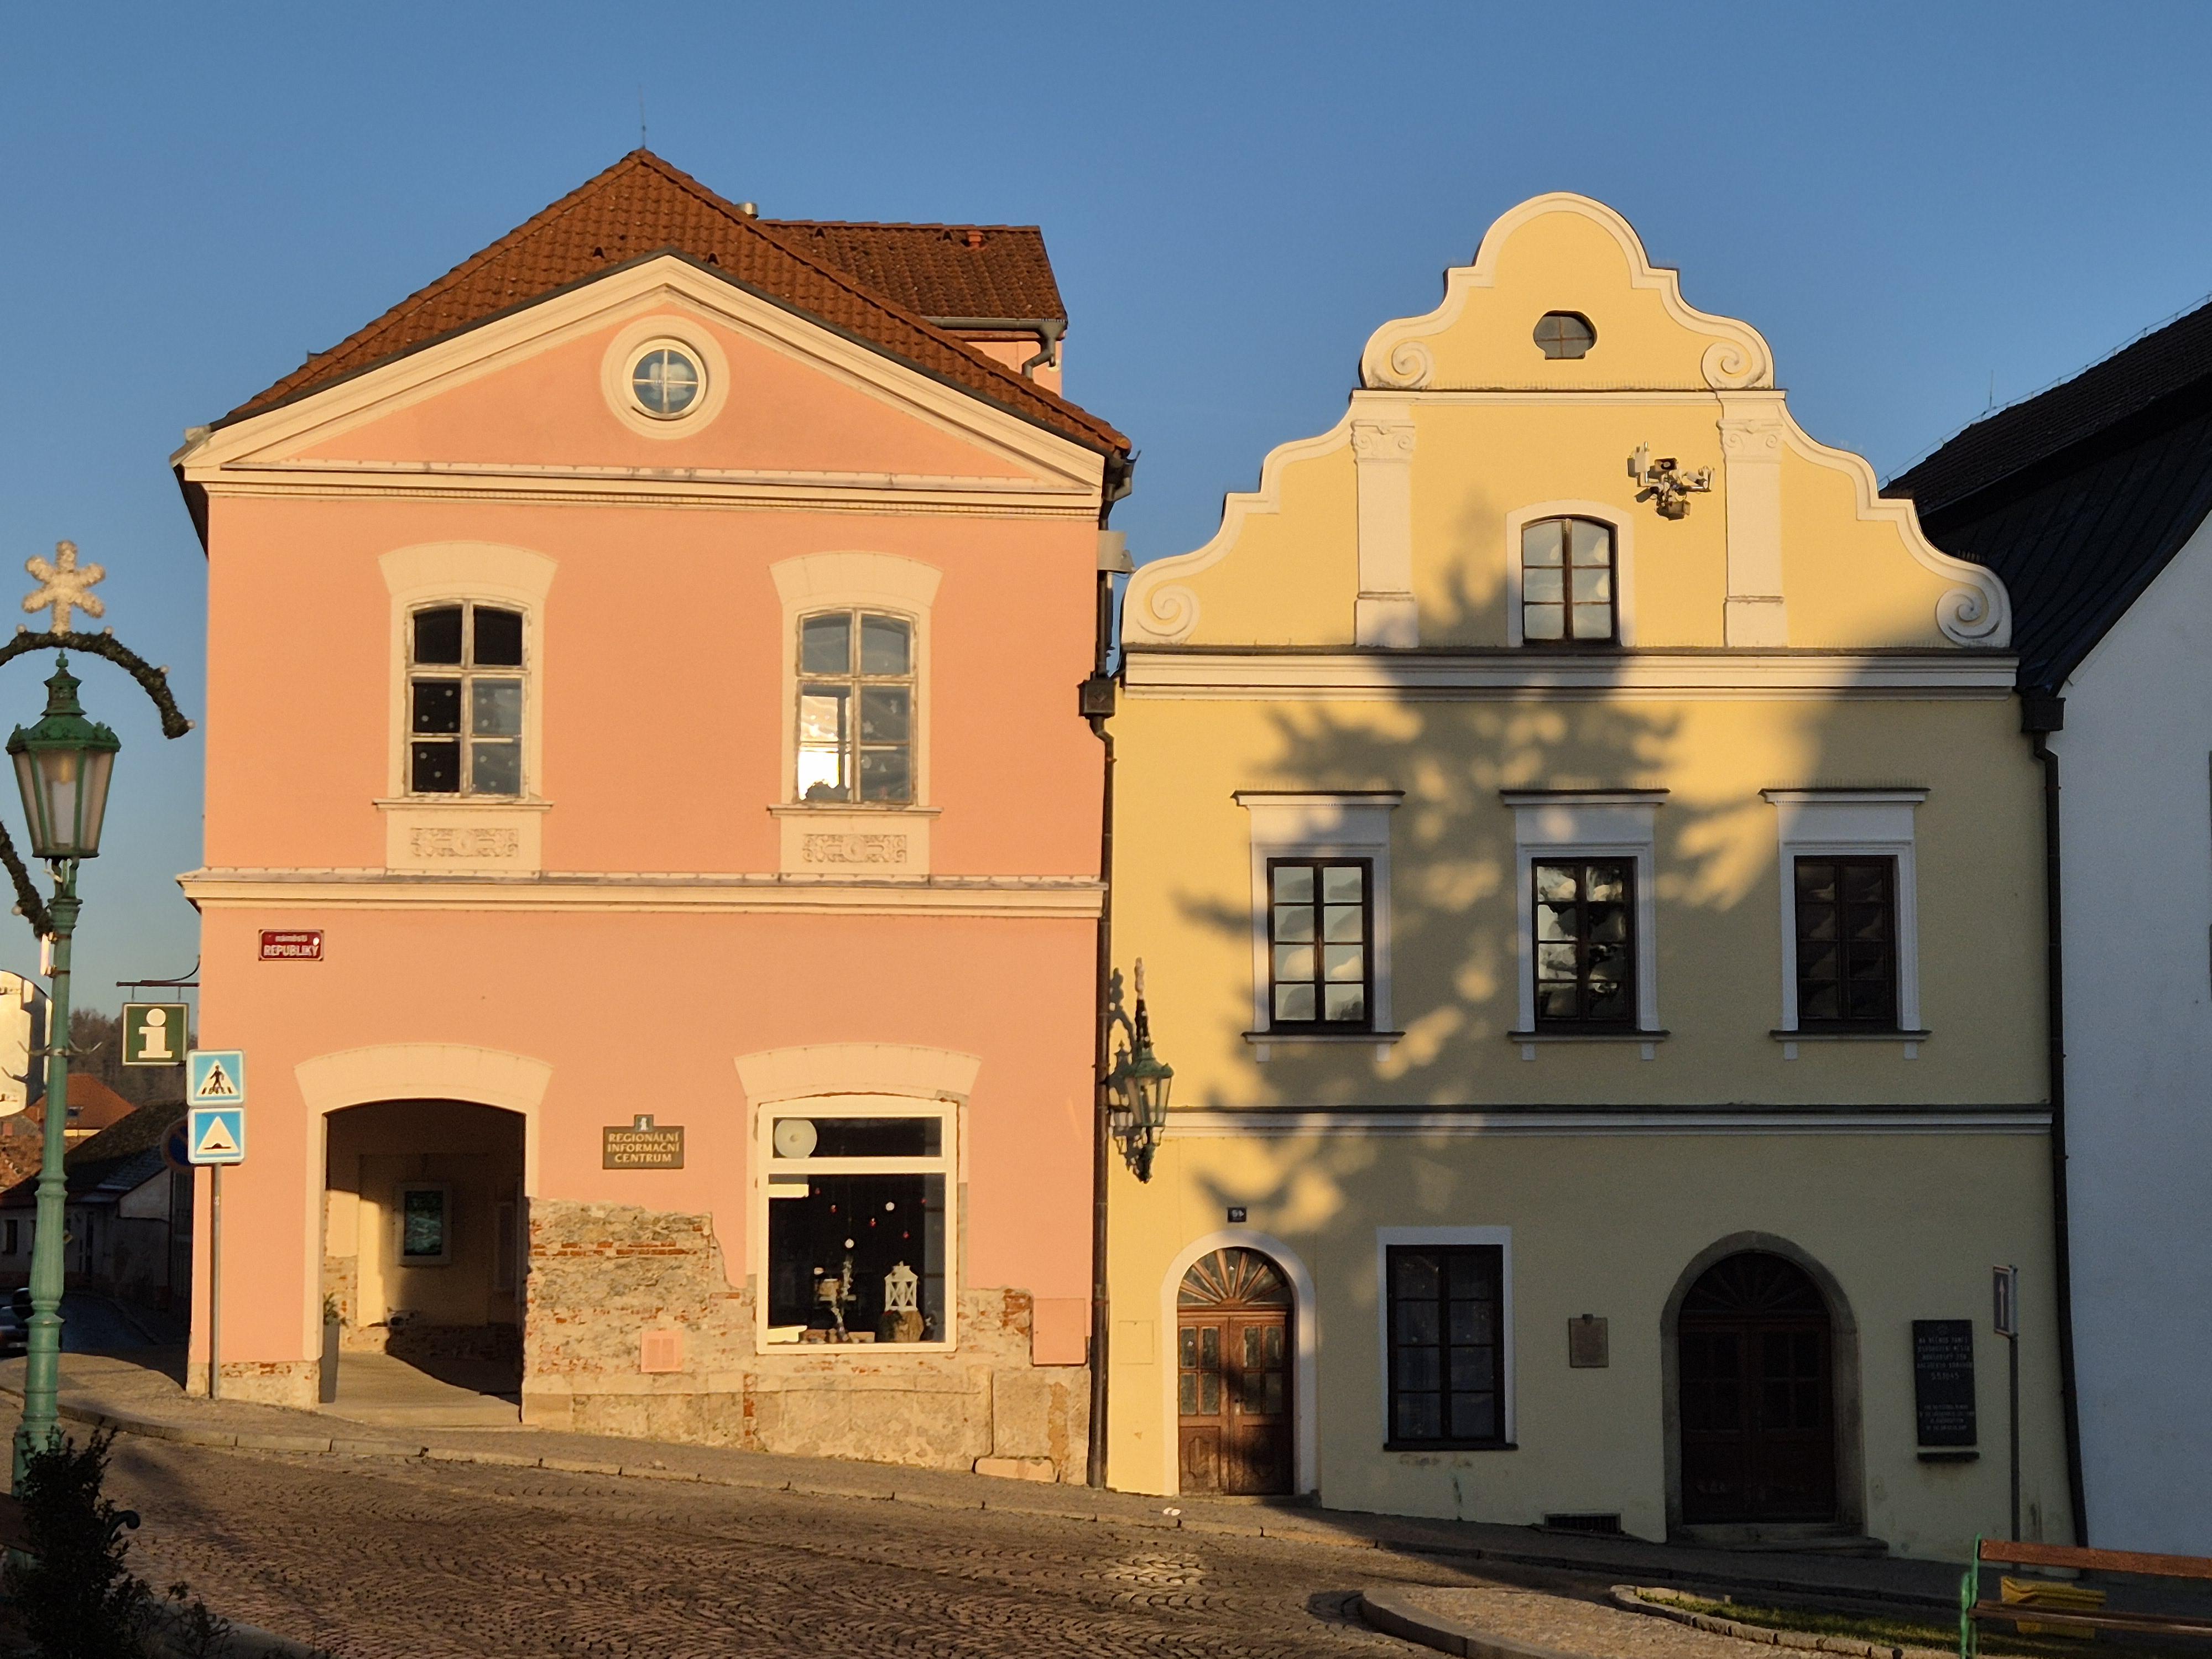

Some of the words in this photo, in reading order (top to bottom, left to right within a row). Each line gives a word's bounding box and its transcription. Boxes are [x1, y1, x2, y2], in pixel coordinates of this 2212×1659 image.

[264, 945, 319, 956] REPUBLIKY
[608, 1131, 679, 1142] REGIONÁLNÍ
[607, 1142, 680, 1152] INFORMAČNÍ
[614, 1154, 672, 1163] CENTRUM
